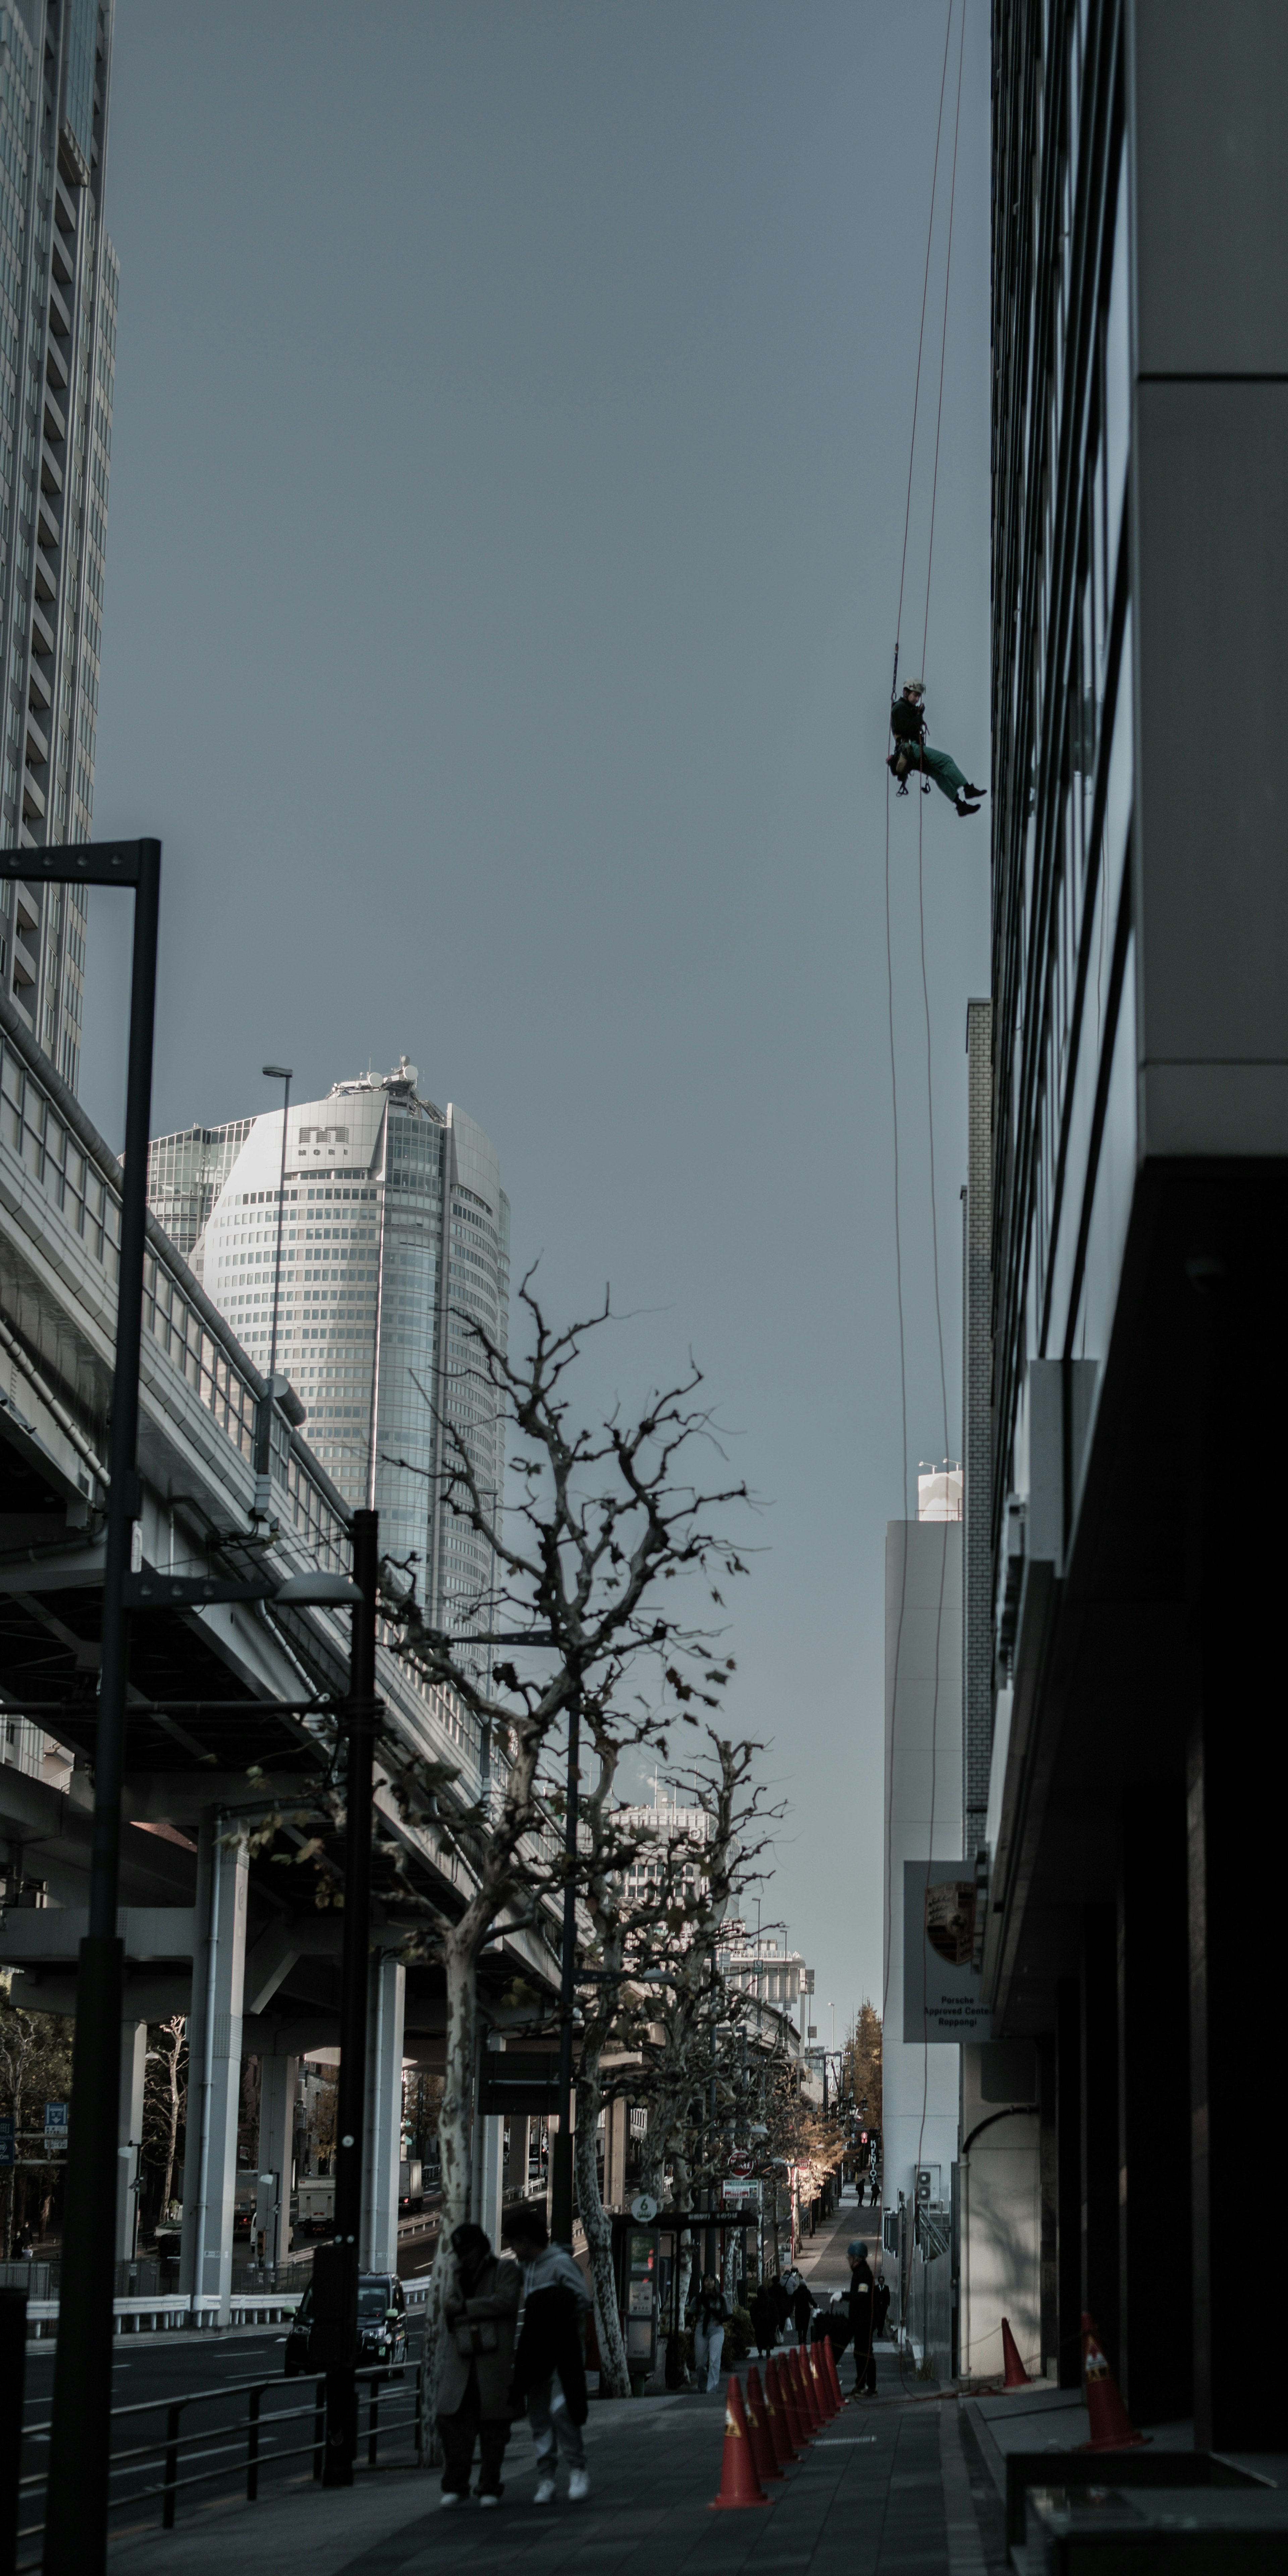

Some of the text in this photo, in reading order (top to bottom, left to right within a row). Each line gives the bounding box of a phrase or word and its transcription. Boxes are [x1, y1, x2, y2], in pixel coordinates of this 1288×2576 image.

[941, 1995, 974, 2003] Porsche
[925, 2007, 962, 2016] Approved
[938, 2017, 977, 2026] Roppongi
[640, 2198, 648, 2210] 6
